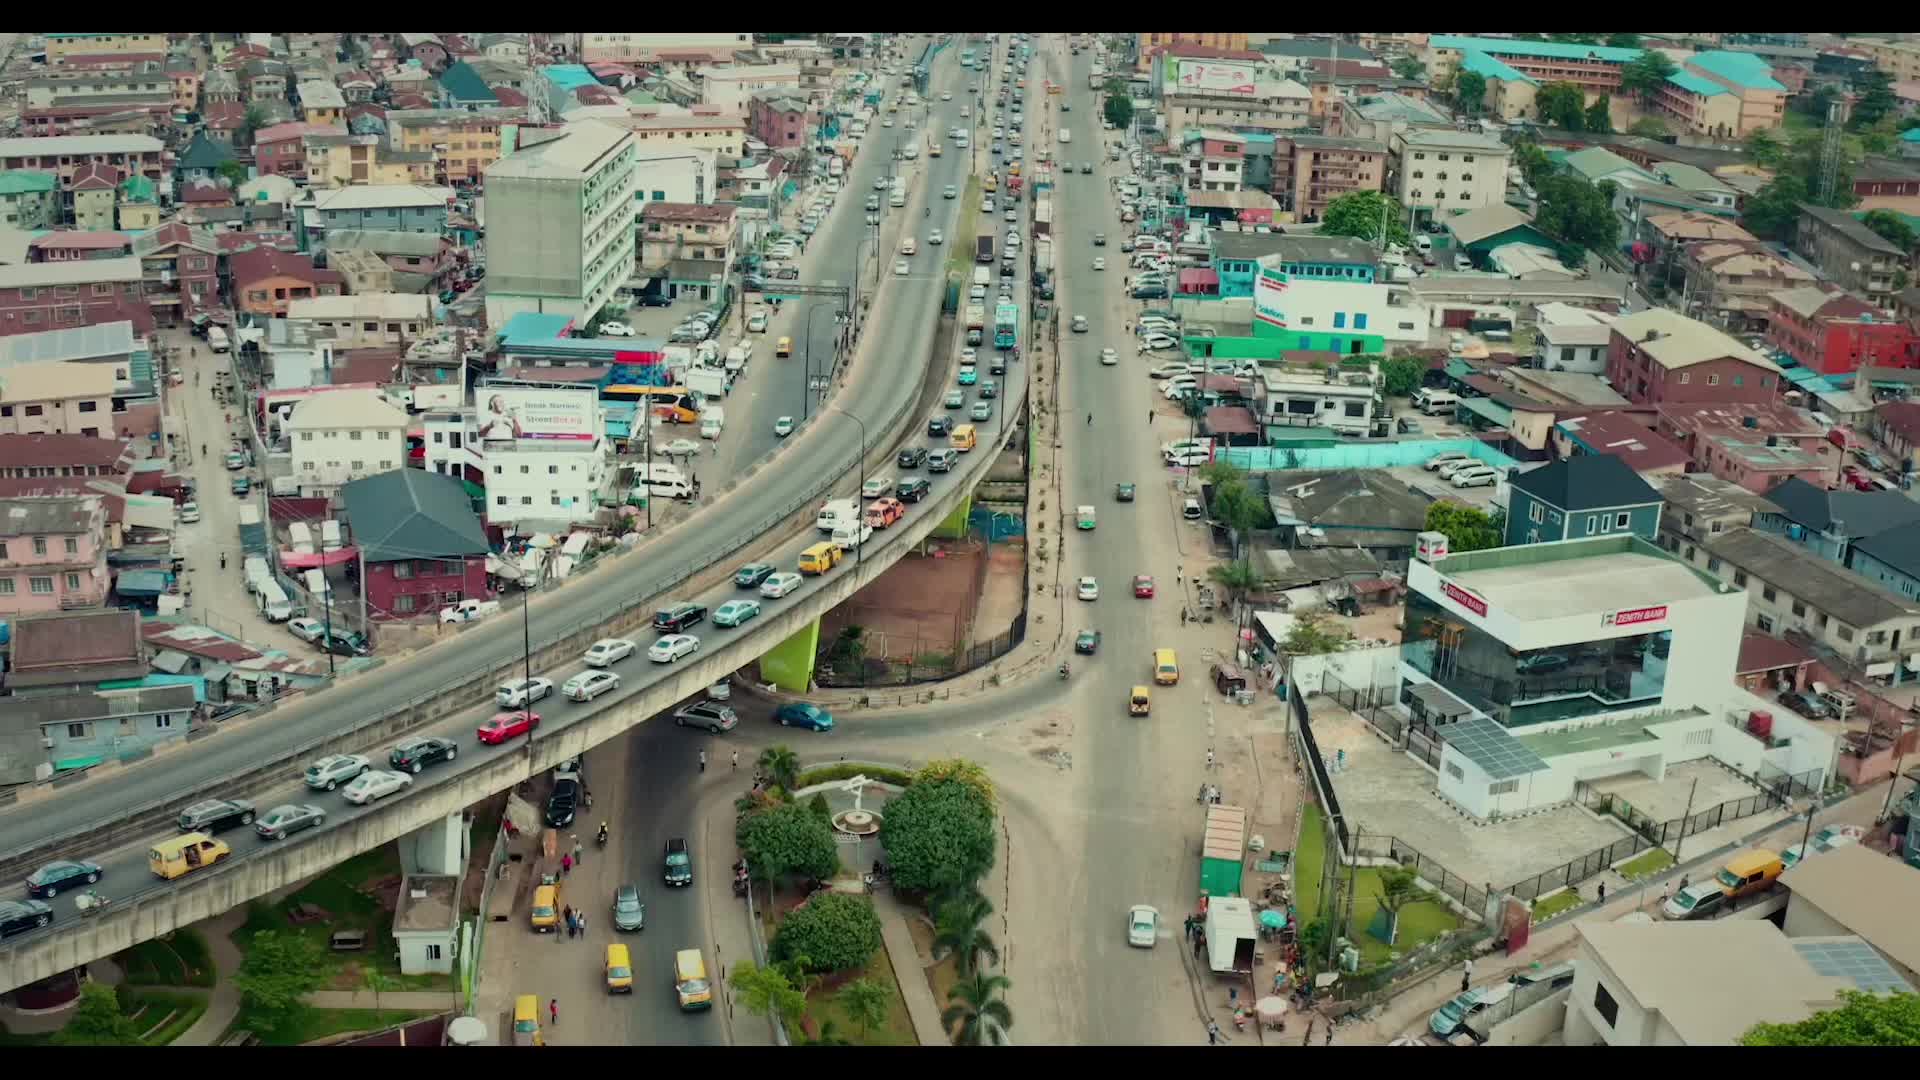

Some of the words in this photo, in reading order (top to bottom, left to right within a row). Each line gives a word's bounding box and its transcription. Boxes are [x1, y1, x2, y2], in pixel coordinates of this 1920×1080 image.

[1447, 586, 1468, 604] ZENITH
[1467, 598, 1484, 615] BANK
[1616, 611, 1643, 623] ZENITH
[1643, 608, 1665, 619] BANK
